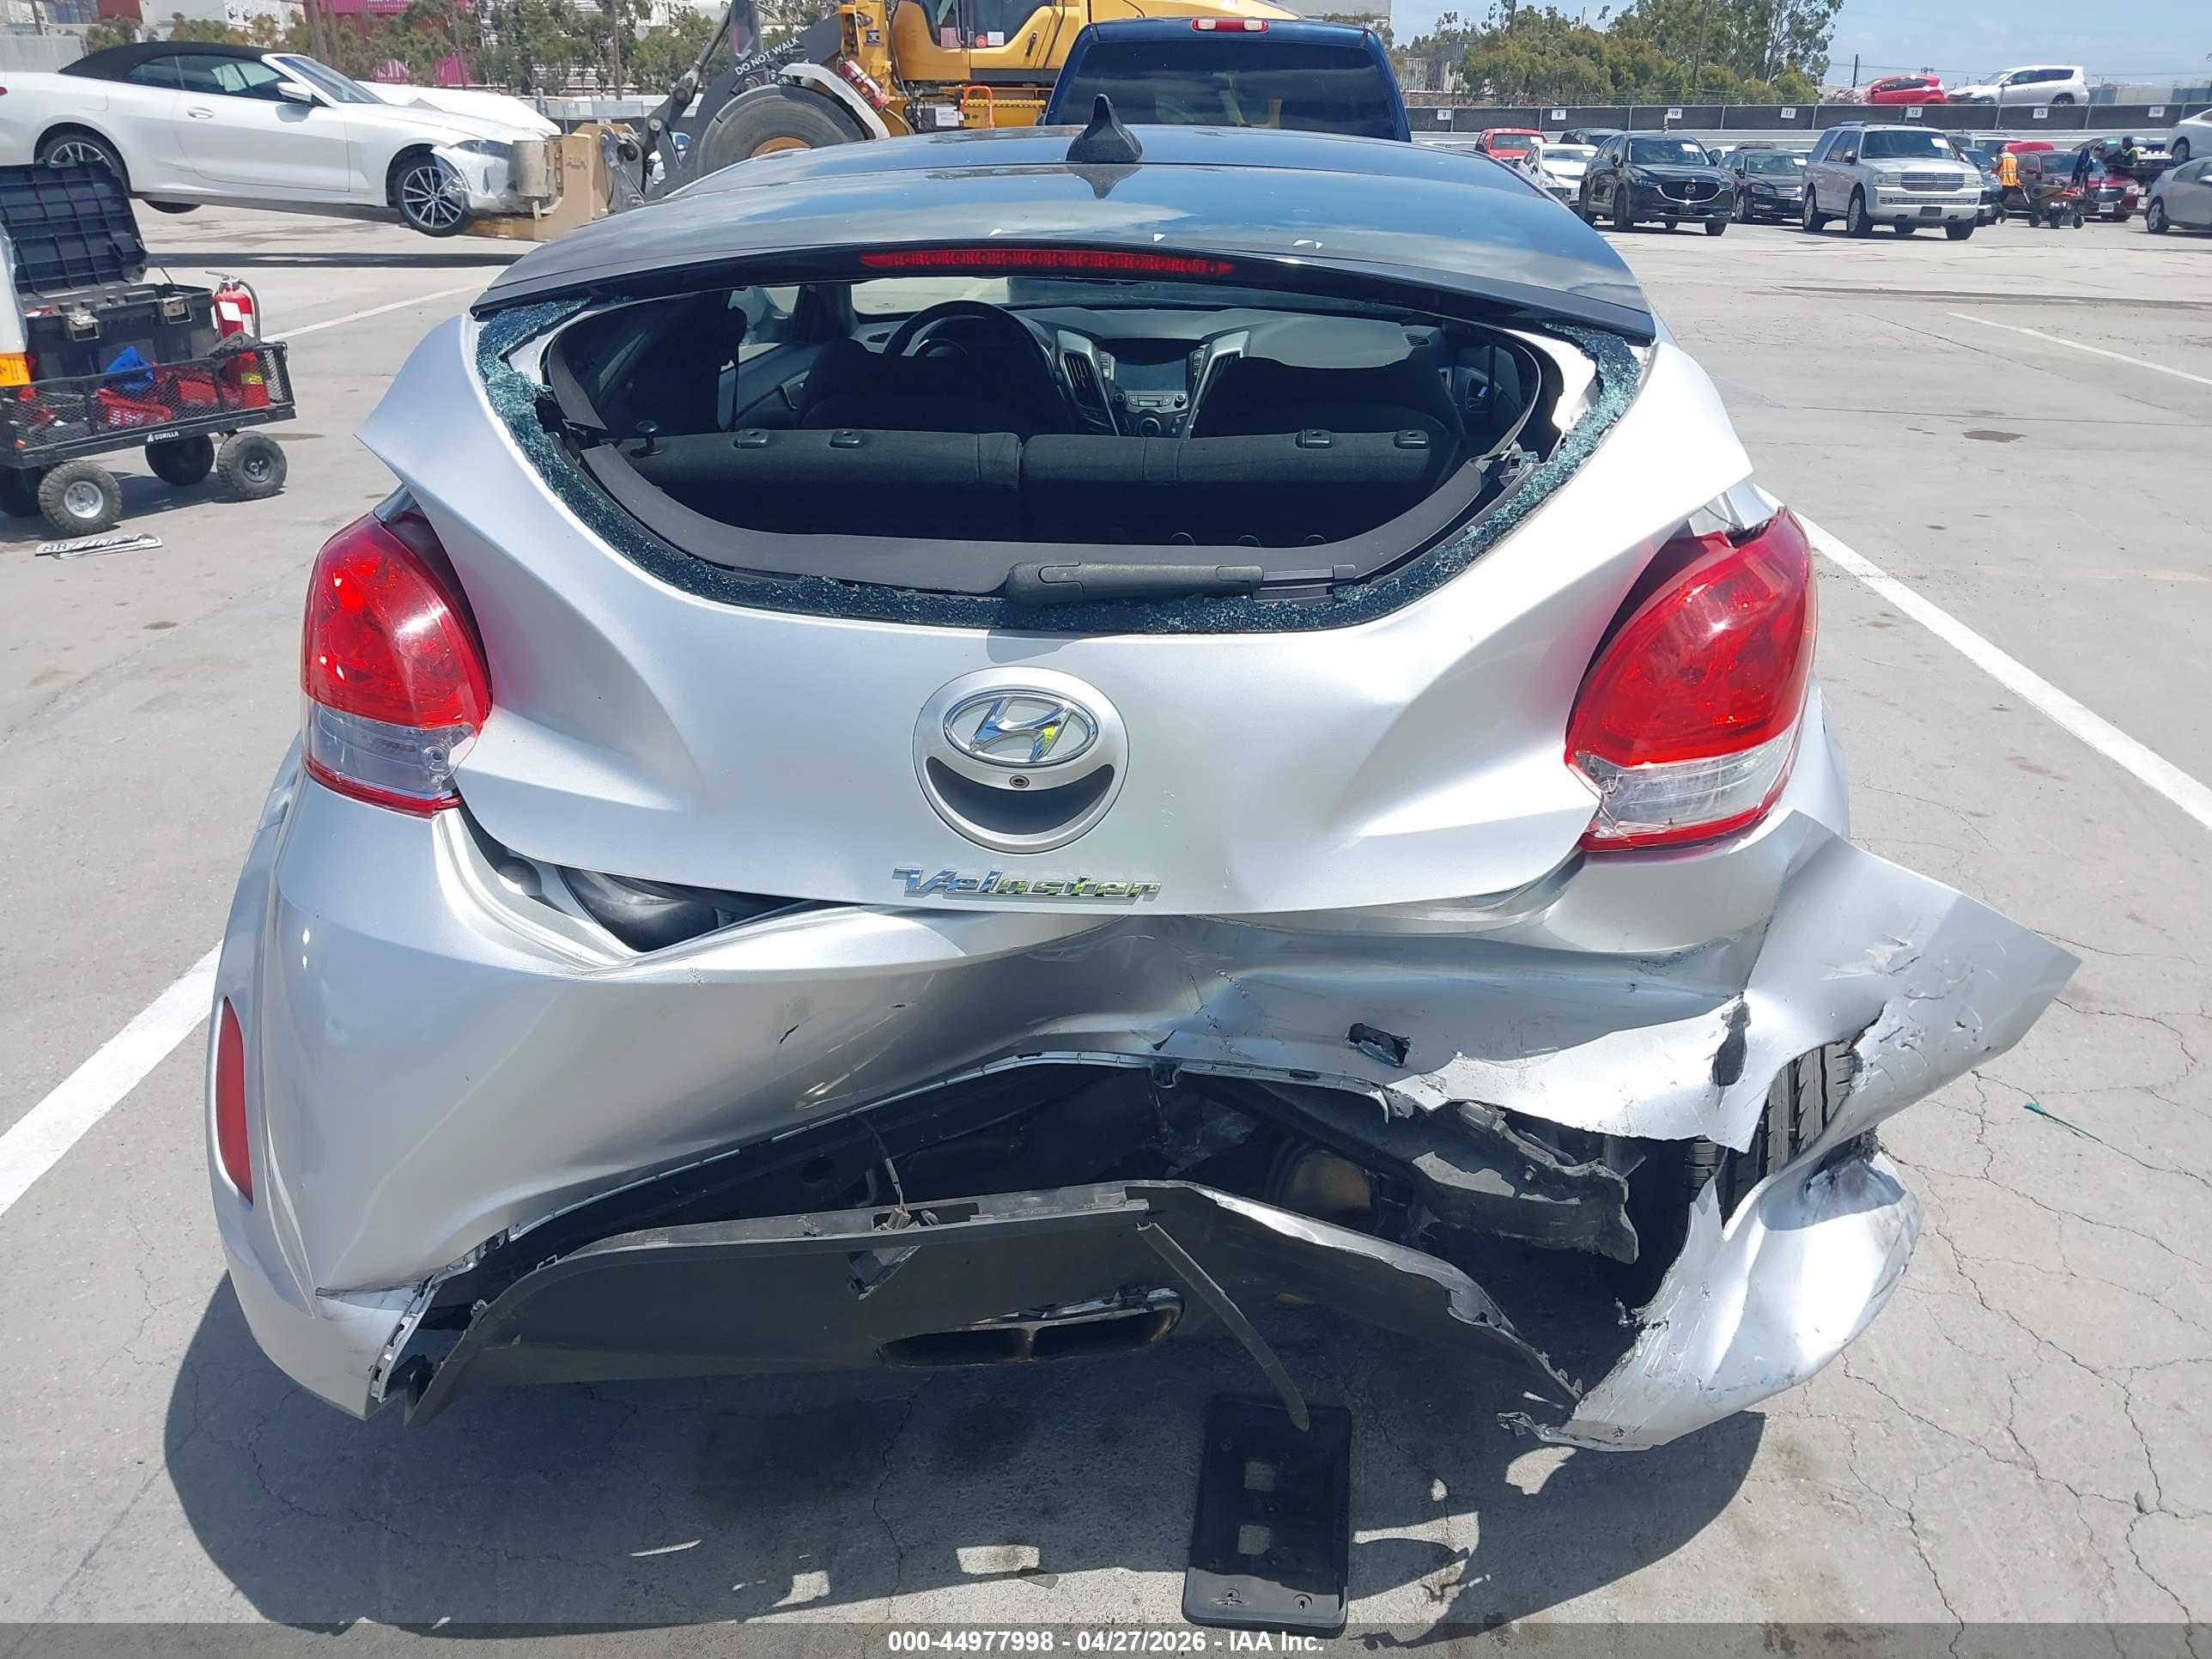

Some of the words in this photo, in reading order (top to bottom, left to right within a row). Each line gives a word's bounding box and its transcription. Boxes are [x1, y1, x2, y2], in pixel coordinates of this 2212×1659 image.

[735, 63, 750, 76] DO
[750, 51, 771, 67] NOT
[771, 36, 800, 55] WALK
[892, 867, 1162, 902] Veloster
